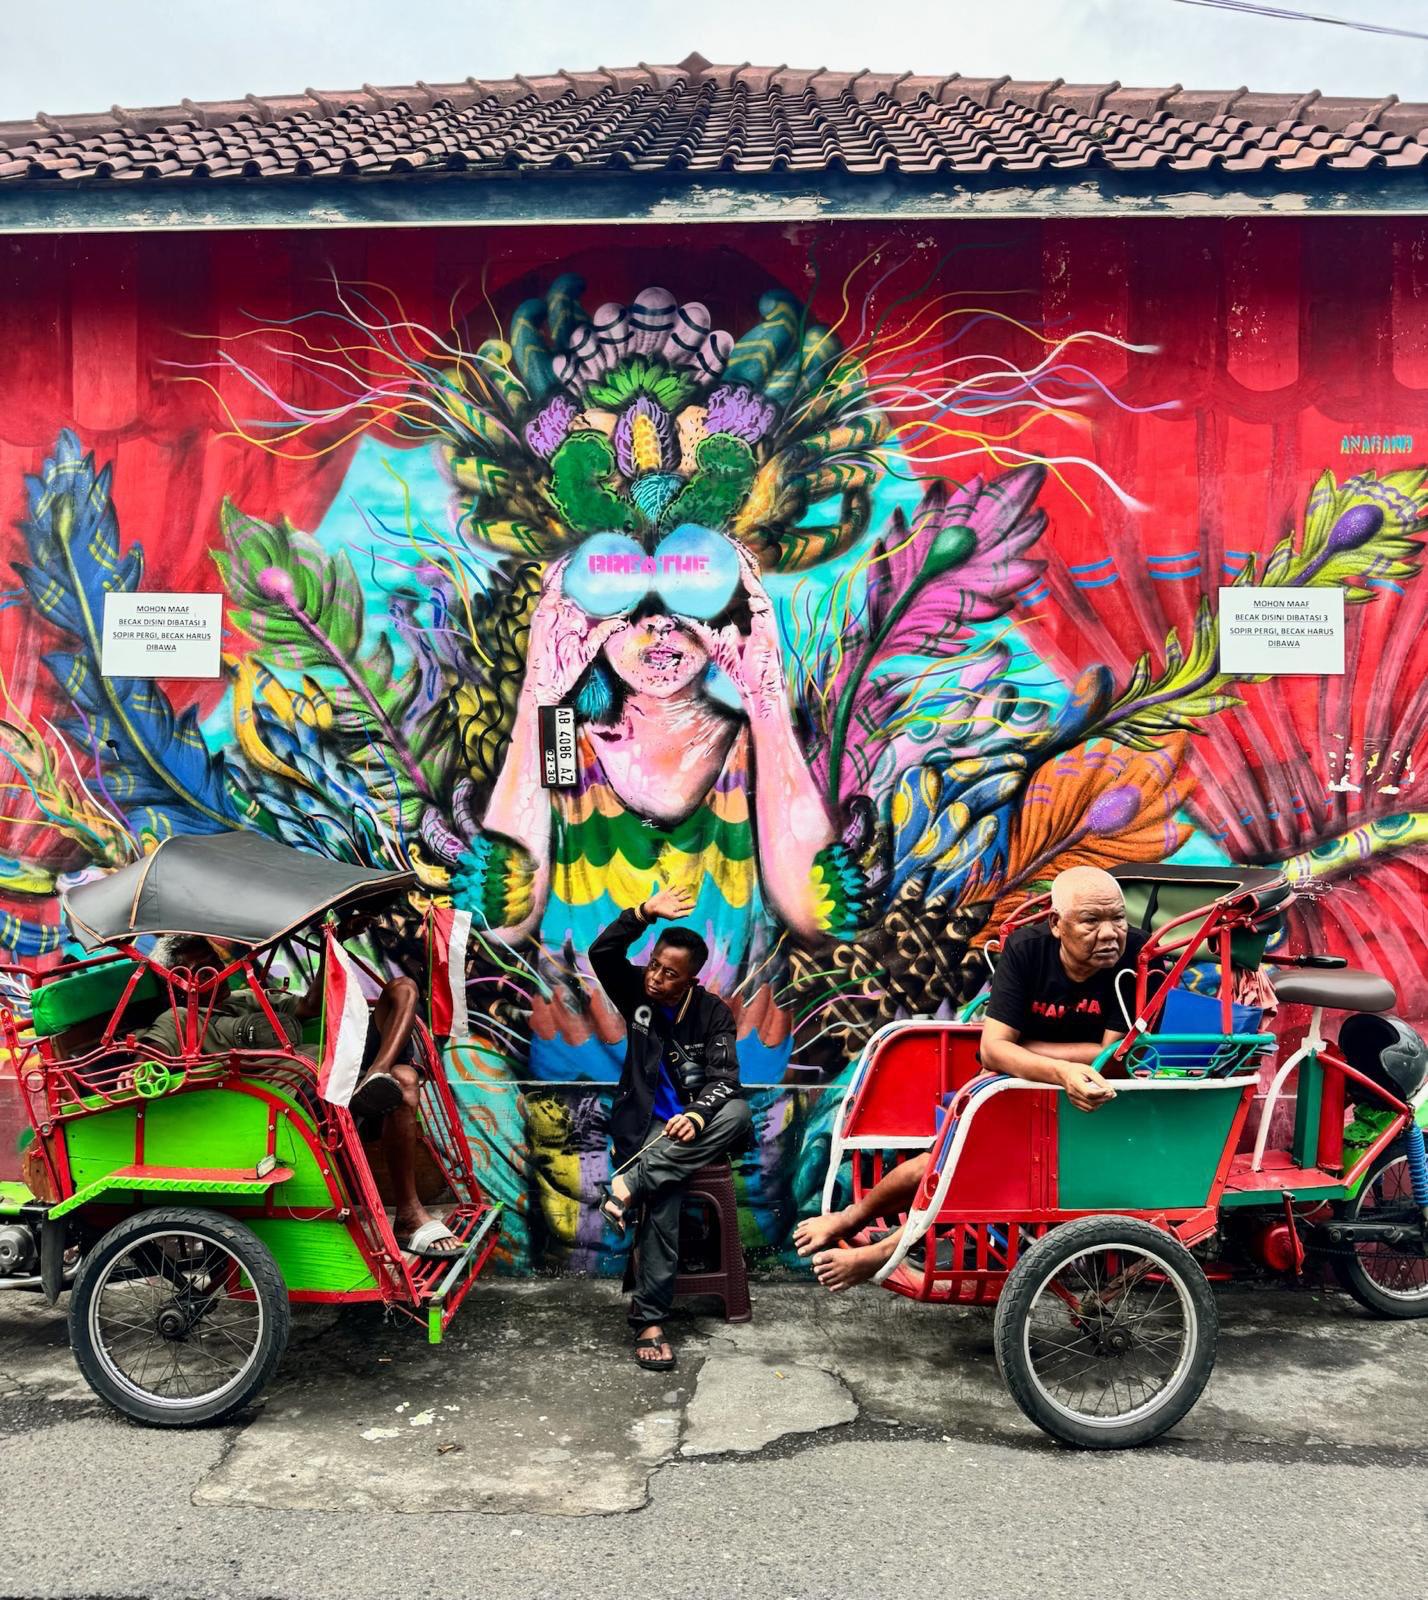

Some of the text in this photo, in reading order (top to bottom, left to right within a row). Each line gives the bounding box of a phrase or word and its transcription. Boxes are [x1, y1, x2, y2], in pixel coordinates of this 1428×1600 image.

[1253, 600, 1310, 608] MOHON MAAF
[136, 605, 166, 613] MOHON
[1235, 613, 1260, 621] BECAK
[1261, 613, 1285, 621] DISINI
[118, 618, 142, 626] BECAK
[112, 631, 135, 640] SOPIR
[136, 632, 160, 640] PERGI,
[161, 632, 184, 640] BECAK
[1230, 627, 1334, 636] SOPIR PERGI, BECAK HARUS
[146, 643, 177, 651] DIBAWA
[1267, 639, 1301, 647] DIBAWA
[558, 710, 574, 782] AB 4086 AZ
